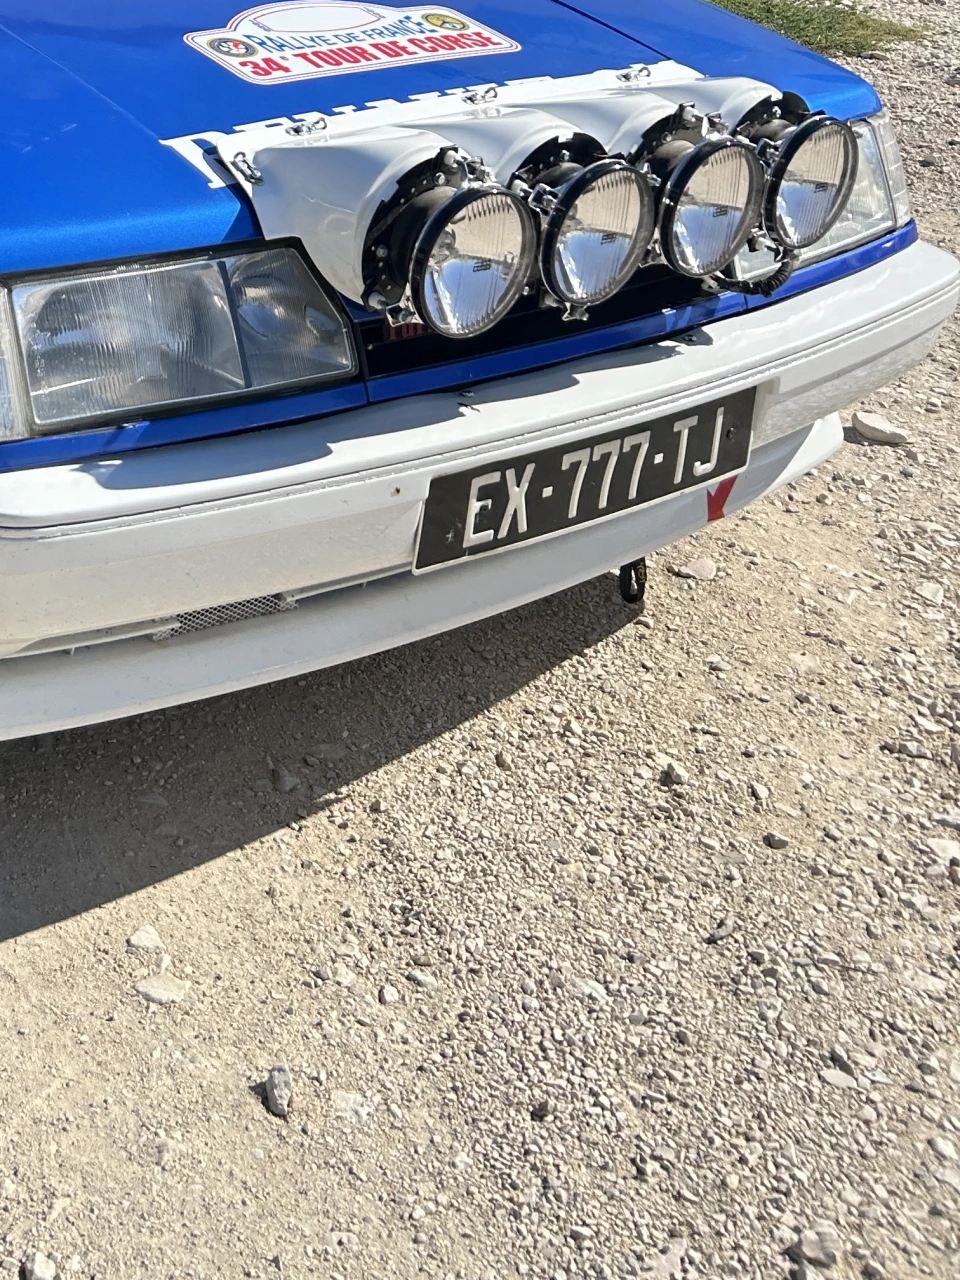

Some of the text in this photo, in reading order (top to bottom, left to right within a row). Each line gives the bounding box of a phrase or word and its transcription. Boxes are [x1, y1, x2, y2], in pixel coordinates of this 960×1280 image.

[242, 15, 440, 54] RALLYE DE FRANCE
[291, 45, 382, 68] TOUR
[368, 40, 419, 58] DE
[406, 31, 503, 53] CORSE
